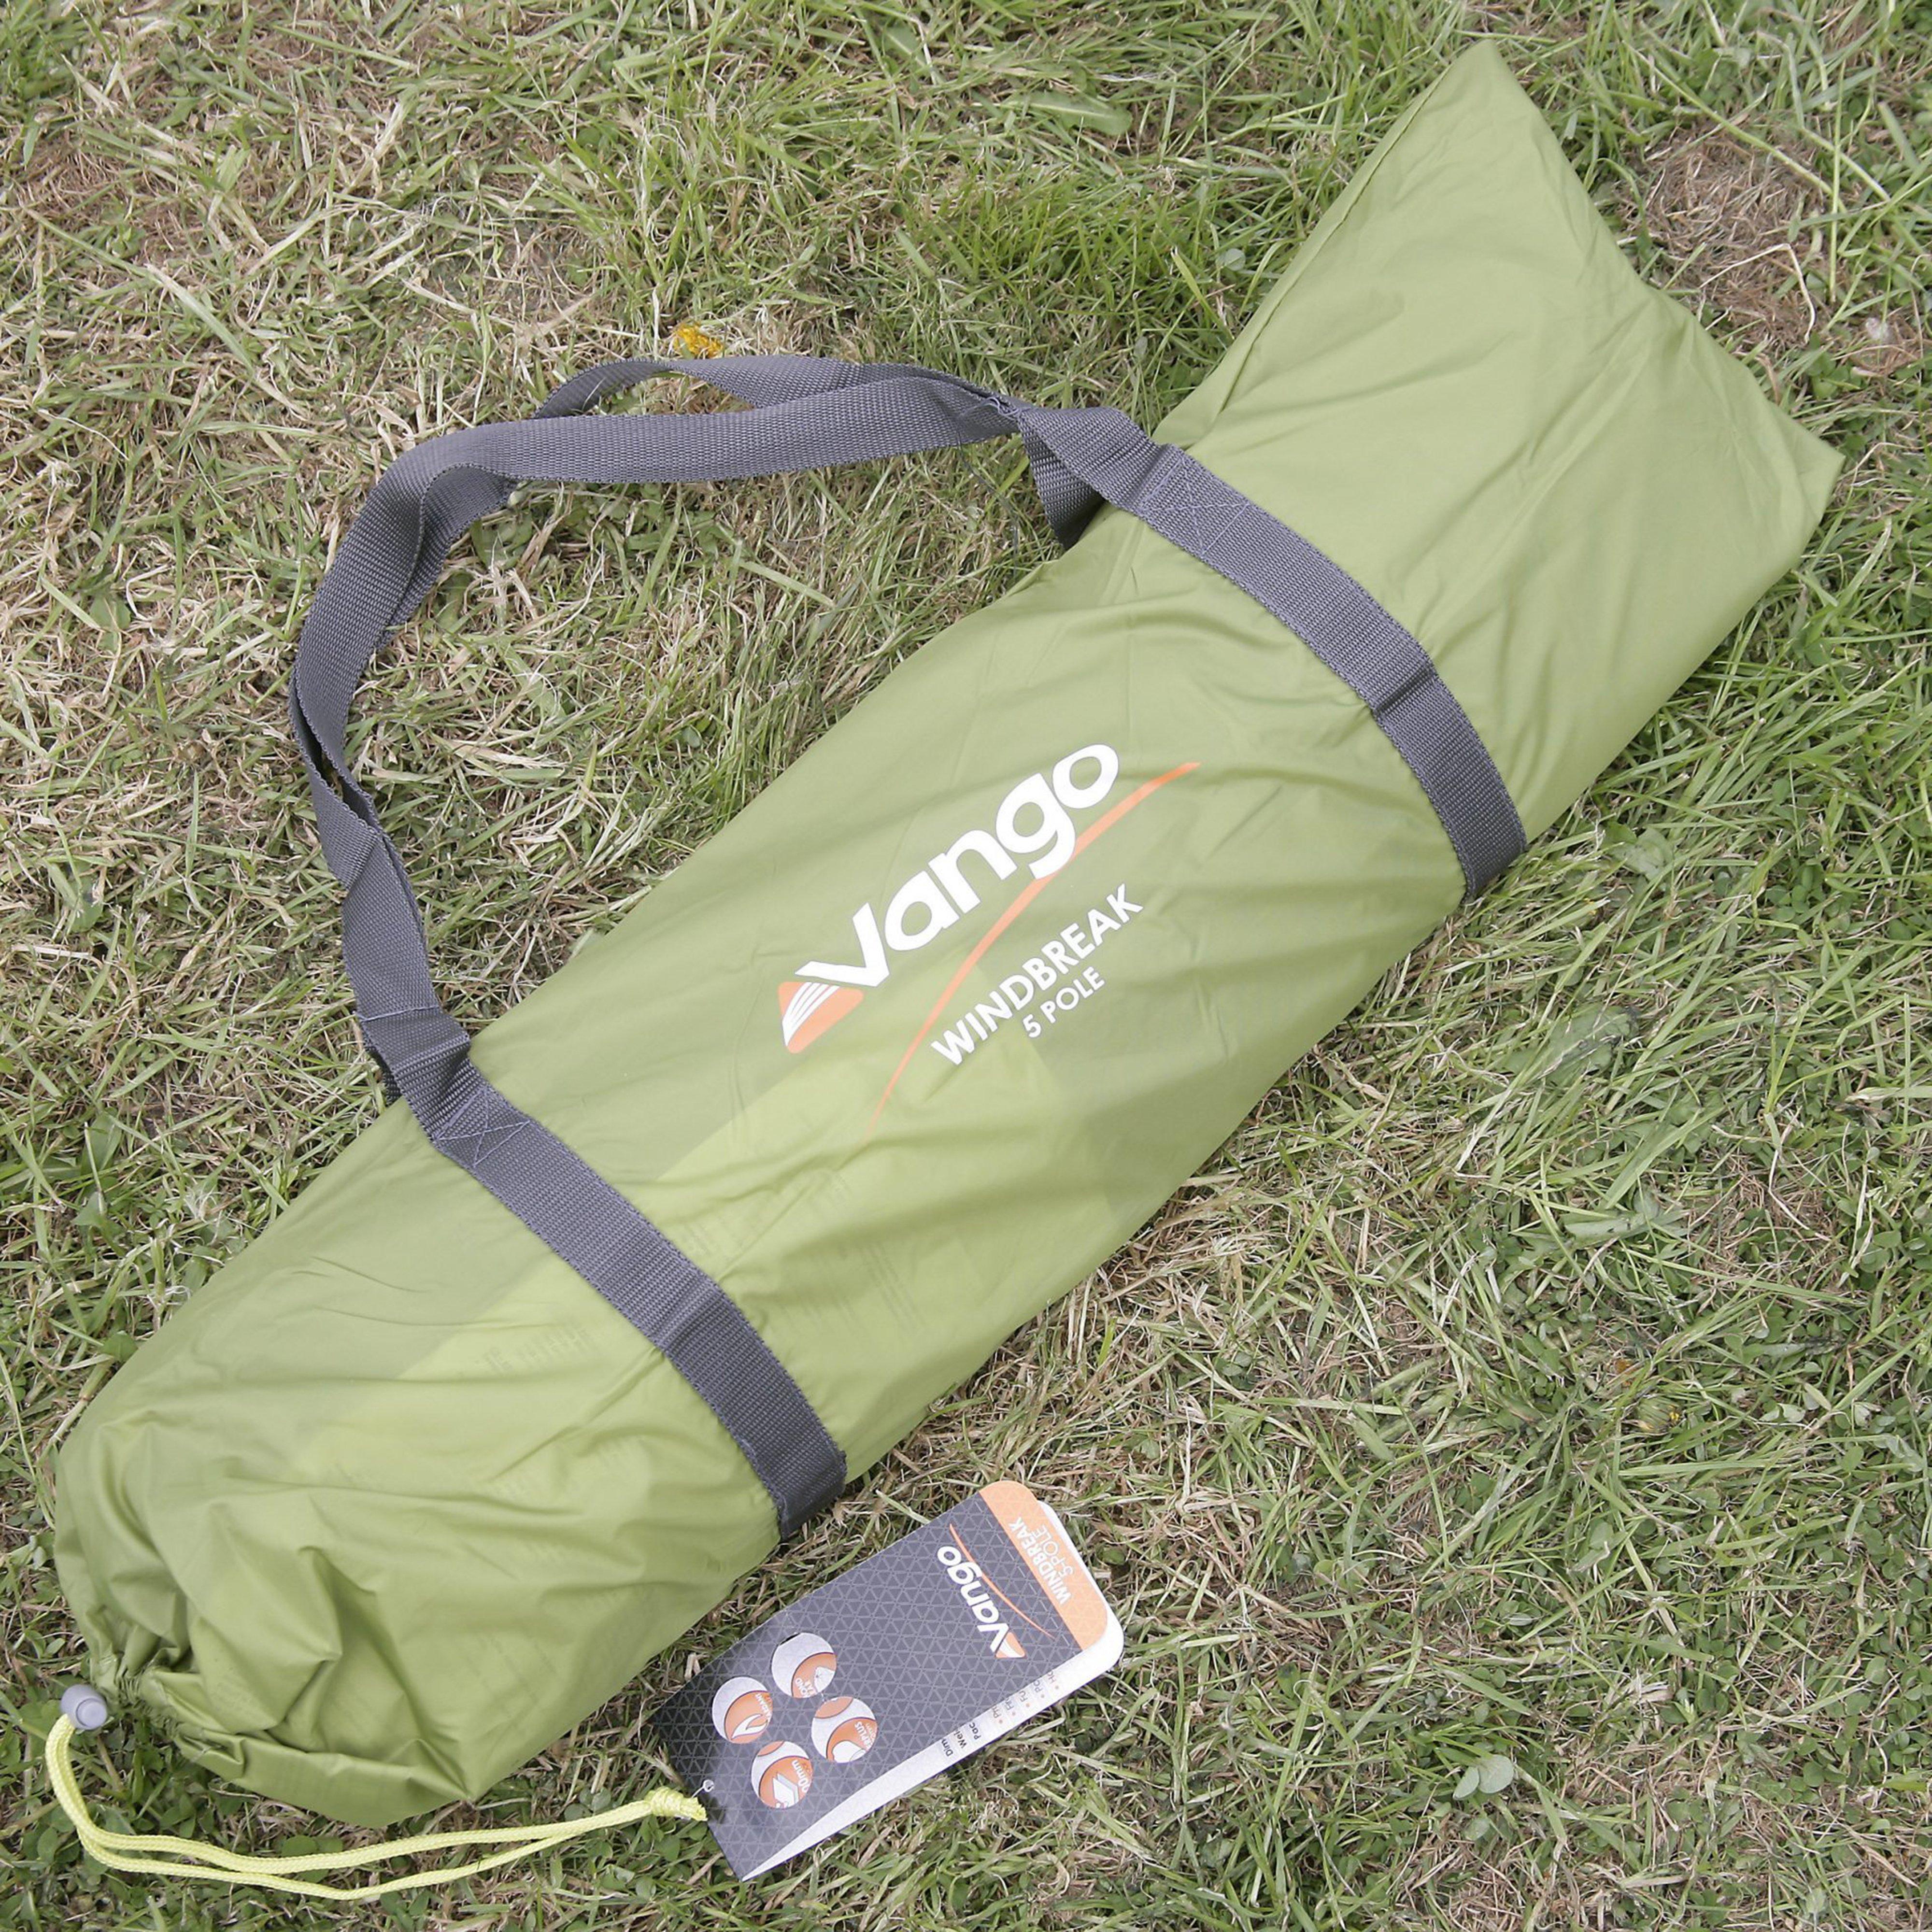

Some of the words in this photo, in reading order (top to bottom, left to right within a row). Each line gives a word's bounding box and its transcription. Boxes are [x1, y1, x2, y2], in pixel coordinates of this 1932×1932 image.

[794, 744, 1119, 987] Vango
[930, 883, 1144, 1065] WINDBREAK
[1022, 1014, 1042, 1038] 5
[1039, 966, 1105, 1023] POLE
[937, 1546, 1009, 1653] Vango
[1009, 1517, 1072, 1605] WINDBREAK
[1031, 1524, 1074, 1579] 5-POLE
